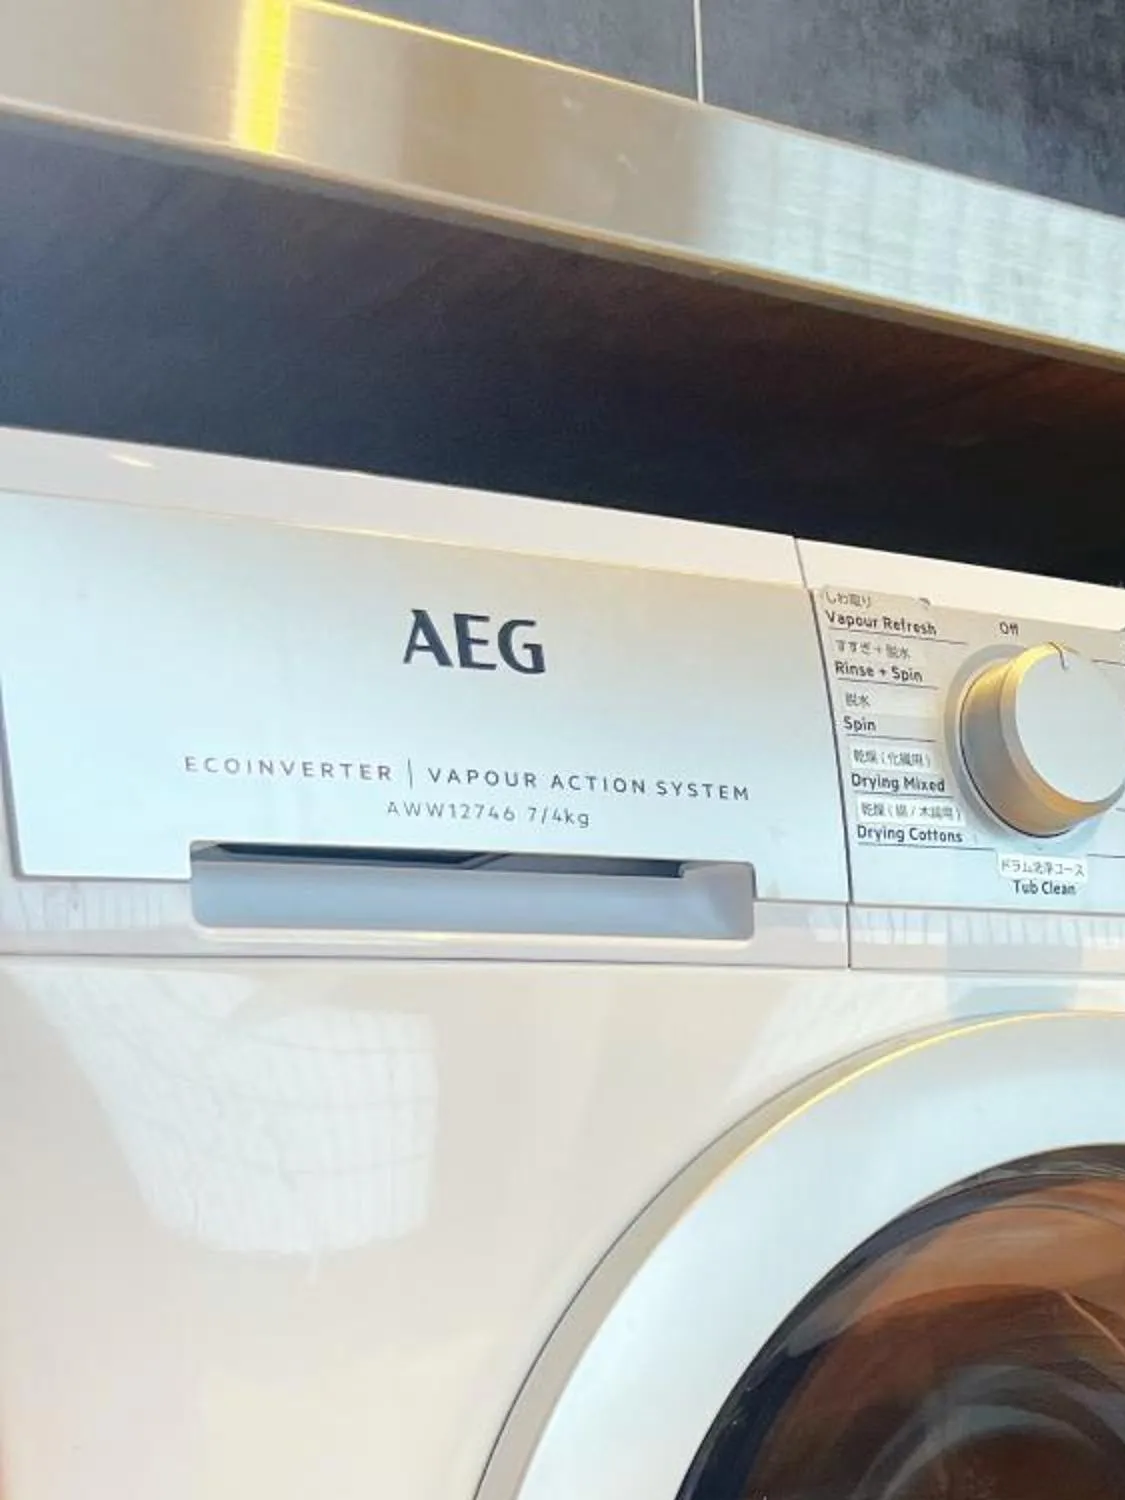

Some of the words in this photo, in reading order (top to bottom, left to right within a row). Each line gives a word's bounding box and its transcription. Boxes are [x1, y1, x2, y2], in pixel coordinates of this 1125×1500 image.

[825, 610, 878, 628] Vapour
[883, 616, 937, 636] Refresh
[1000, 621, 1018, 636] Off
[402, 608, 546, 675] AEG
[834, 660, 875, 678] Rinse
[891, 665, 923, 683] Spin
[845, 692, 871, 709] 脱水
[843, 715, 877, 733] Spin
[184, 755, 393, 781] ECOINVERTER
[427, 766, 538, 790] VAPOUR
[550, 772, 646, 795] ACTION
[656, 778, 750, 802] SYSTEM
[851, 772, 899, 793] Drying
[903, 775, 946, 793] Mixed
[386, 799, 517, 824] AWW12746
[527, 805, 591, 829] 7/4kg
[858, 824, 905, 843] Drying
[909, 827, 964, 843] Cottons
[1013, 879, 1039, 895] Tub
[1041, 880, 1077, 896] Clean
